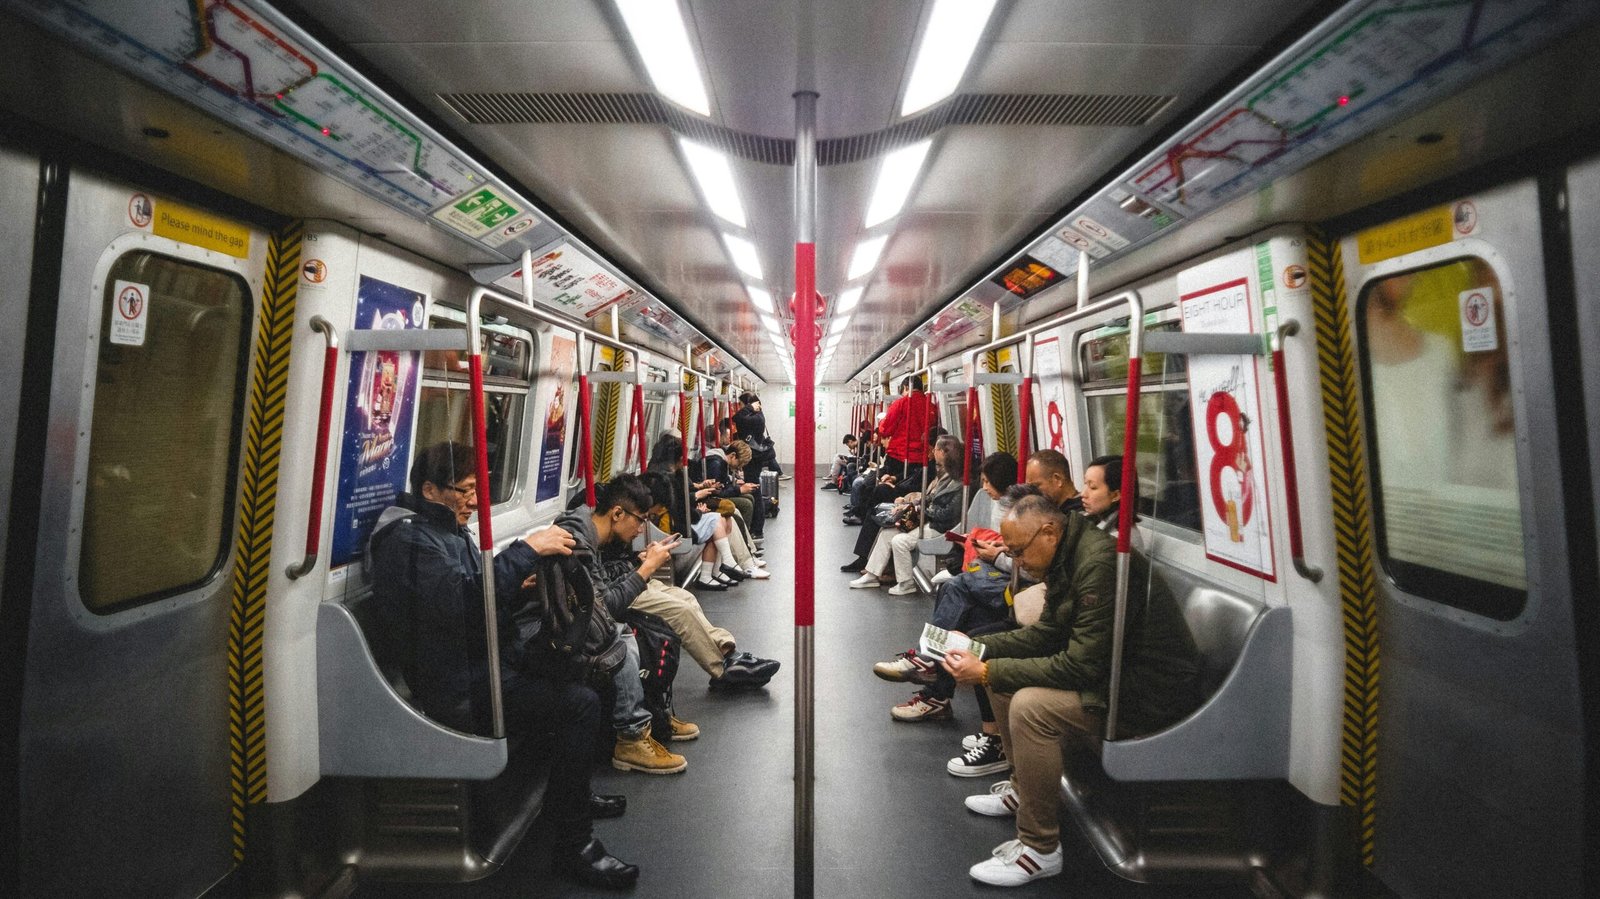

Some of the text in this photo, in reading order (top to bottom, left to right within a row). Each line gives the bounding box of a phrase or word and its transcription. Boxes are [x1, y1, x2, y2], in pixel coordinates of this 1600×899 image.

[161, 212, 244, 248] Please mind the gap
[1184, 293, 1244, 319] EIGHT HOUR
[1207, 391, 1253, 527] 8
